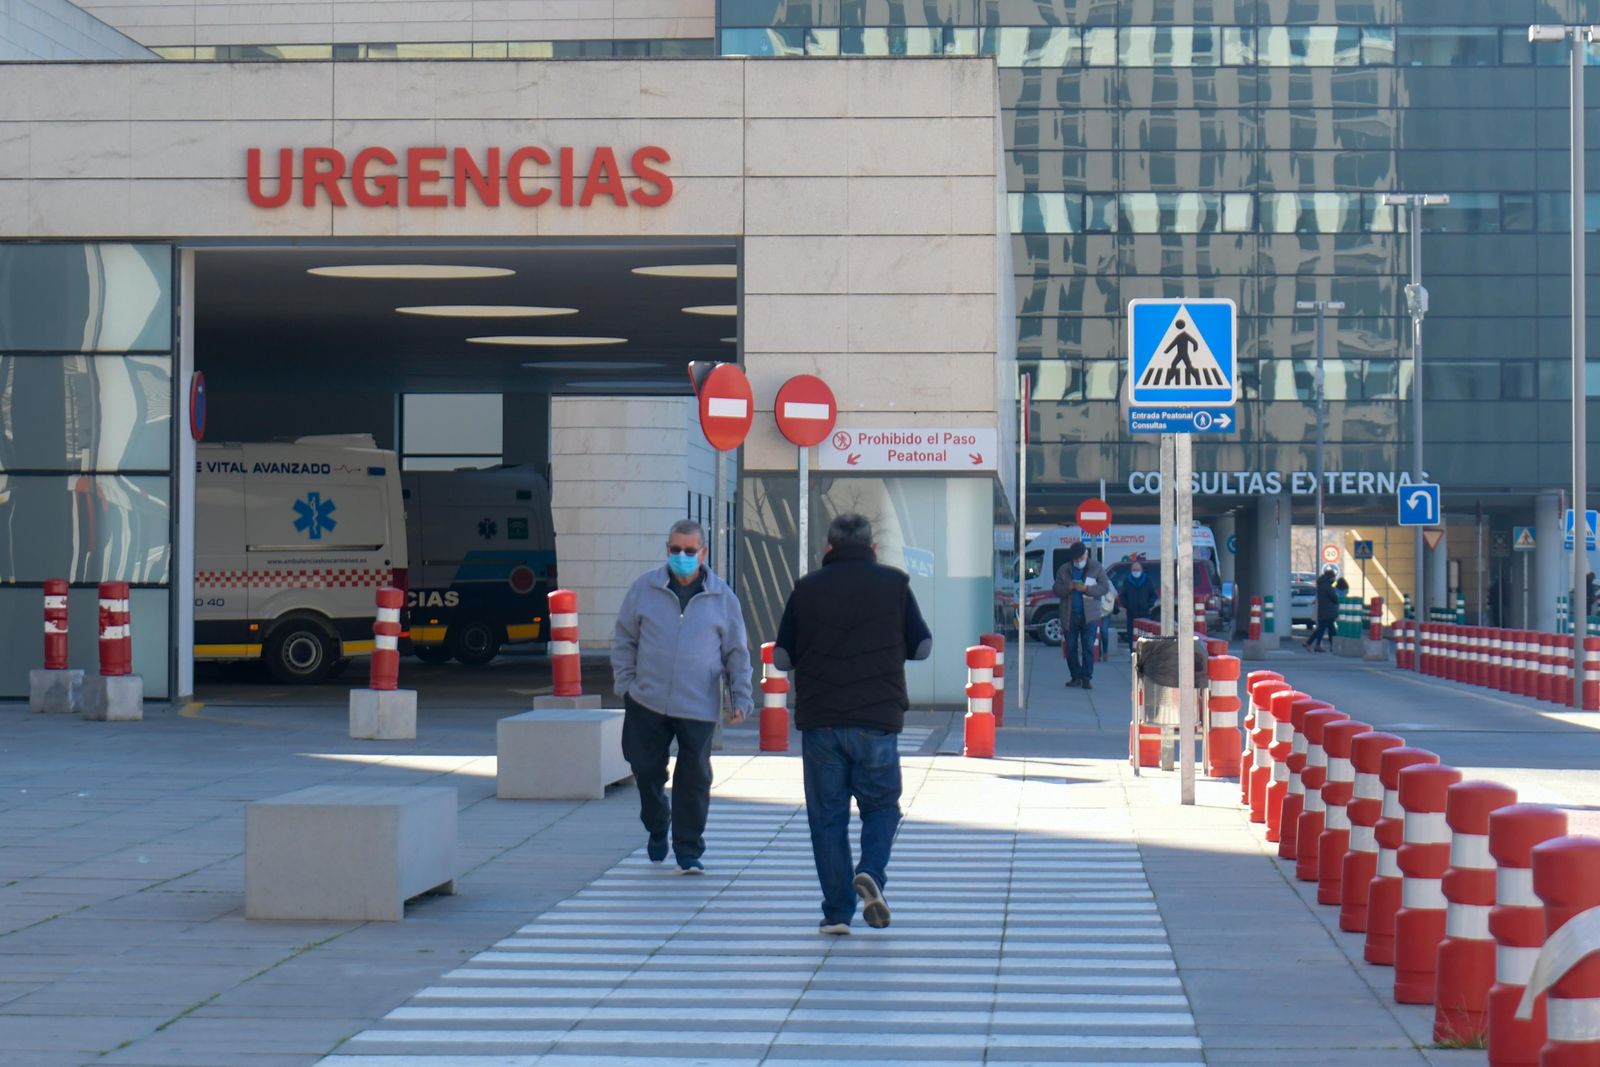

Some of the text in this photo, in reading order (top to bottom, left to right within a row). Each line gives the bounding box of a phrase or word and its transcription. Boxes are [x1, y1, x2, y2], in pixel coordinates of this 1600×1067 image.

[247, 146, 674, 208] URGENCIAS
[1132, 411, 1193, 419] Entrada Peatonal
[1132, 421, 1167, 429] Consultas
[858, 432, 976, 445] Prohibido el Paso
[887, 449, 947, 462] Peatonal
[207, 462, 248, 473] VITAL
[253, 463, 331, 474] AVANZADO
[1128, 471, 1281, 494] COSULTAS
[207, 598, 225, 607] 40
